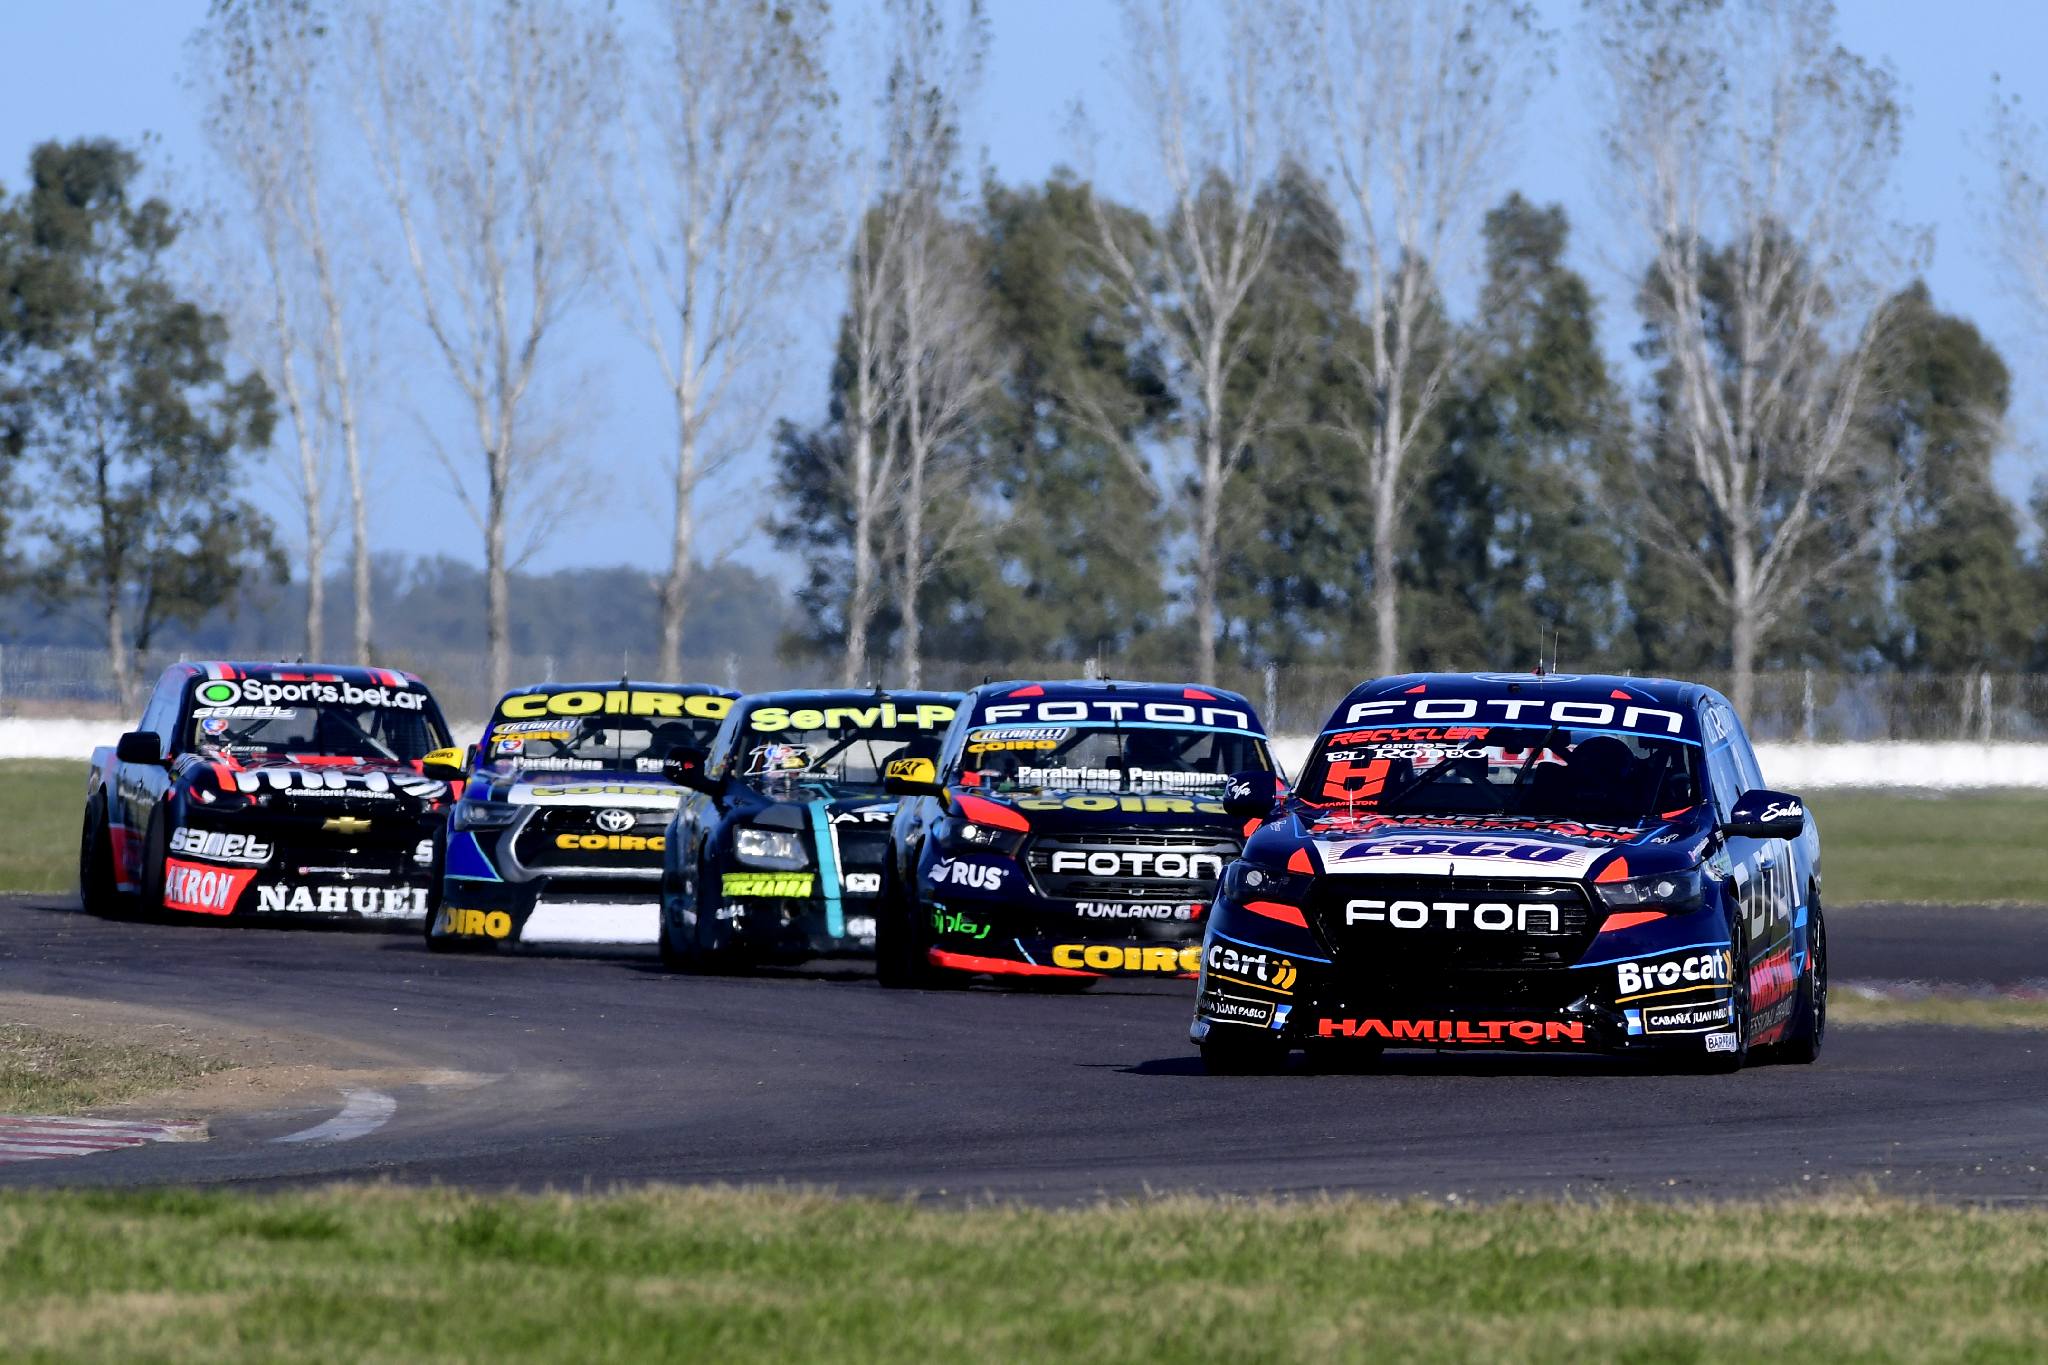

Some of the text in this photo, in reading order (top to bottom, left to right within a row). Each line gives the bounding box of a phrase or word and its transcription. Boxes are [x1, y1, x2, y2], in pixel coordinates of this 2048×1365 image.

[242, 679, 427, 711] Sports.bet.ar
[501, 690, 735, 719] COIRO
[985, 701, 1248, 729] FOTON
[1345, 699, 1684, 734] FOTON
[967, 740, 1057, 754] COIRO
[1325, 750, 1366, 763] EL
[1374, 747, 1488, 760] RODEO
[1018, 766, 1121, 780] Parabrisas
[1052, 851, 1223, 880] FOTON
[164, 865, 235, 910] AKRON
[1075, 902, 1172, 919] TUNLAND
[1346, 899, 1559, 931] FOTON
[1209, 944, 1268, 982] cart
[1216, 1002, 1238, 1015] JUAN
[1238, 1006, 1267, 1019] PABLO
[1692, 1009, 1712, 1025] JUAN
[1318, 1018, 1584, 1042] HAMILTON
